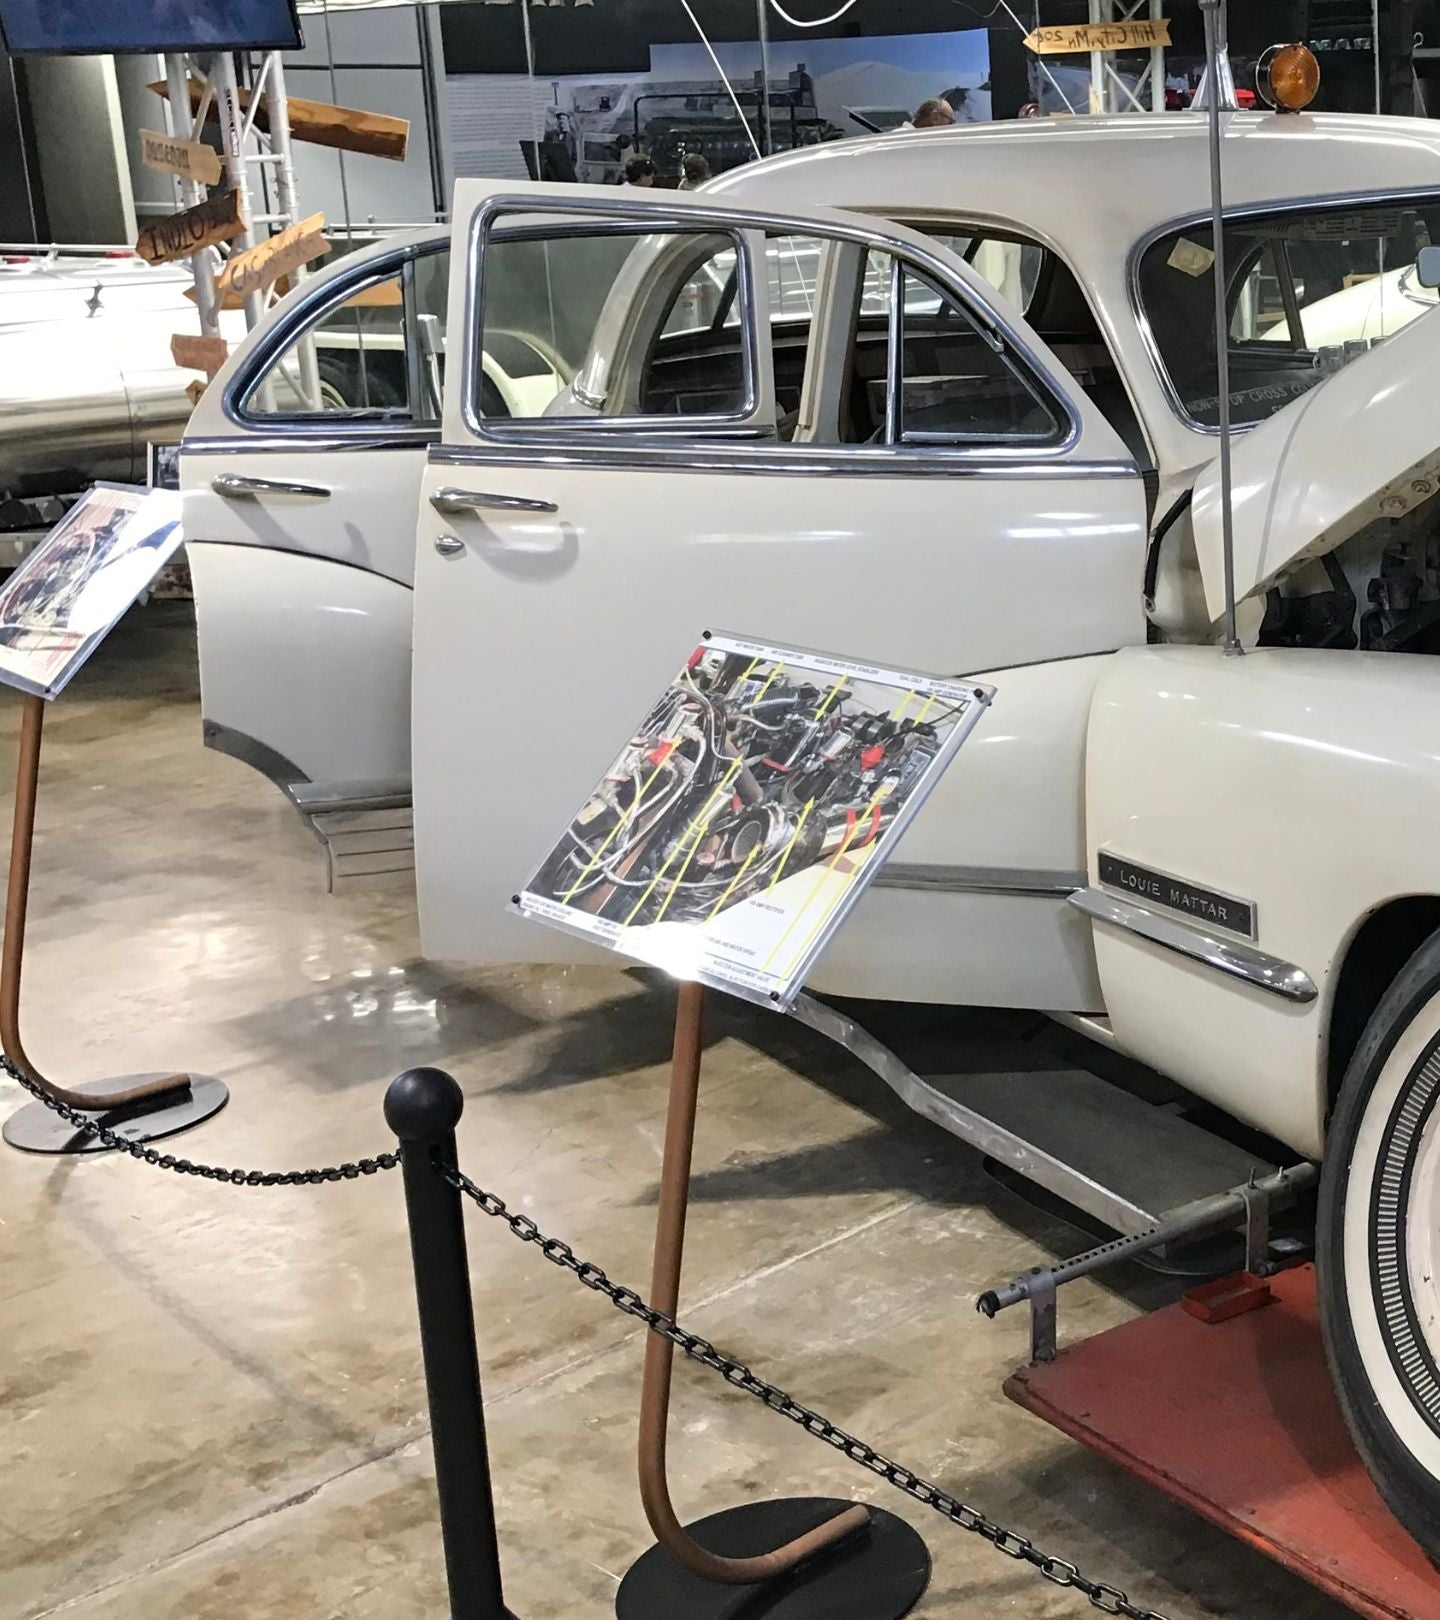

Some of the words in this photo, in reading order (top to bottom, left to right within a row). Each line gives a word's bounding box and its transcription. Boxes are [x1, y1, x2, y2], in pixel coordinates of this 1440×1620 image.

[145, 213, 206, 261] INDIO
[1249, 388, 1288, 402] CROSS
[1120, 869, 1161, 896] LOUIE
[1170, 888, 1228, 920] MATTAR
